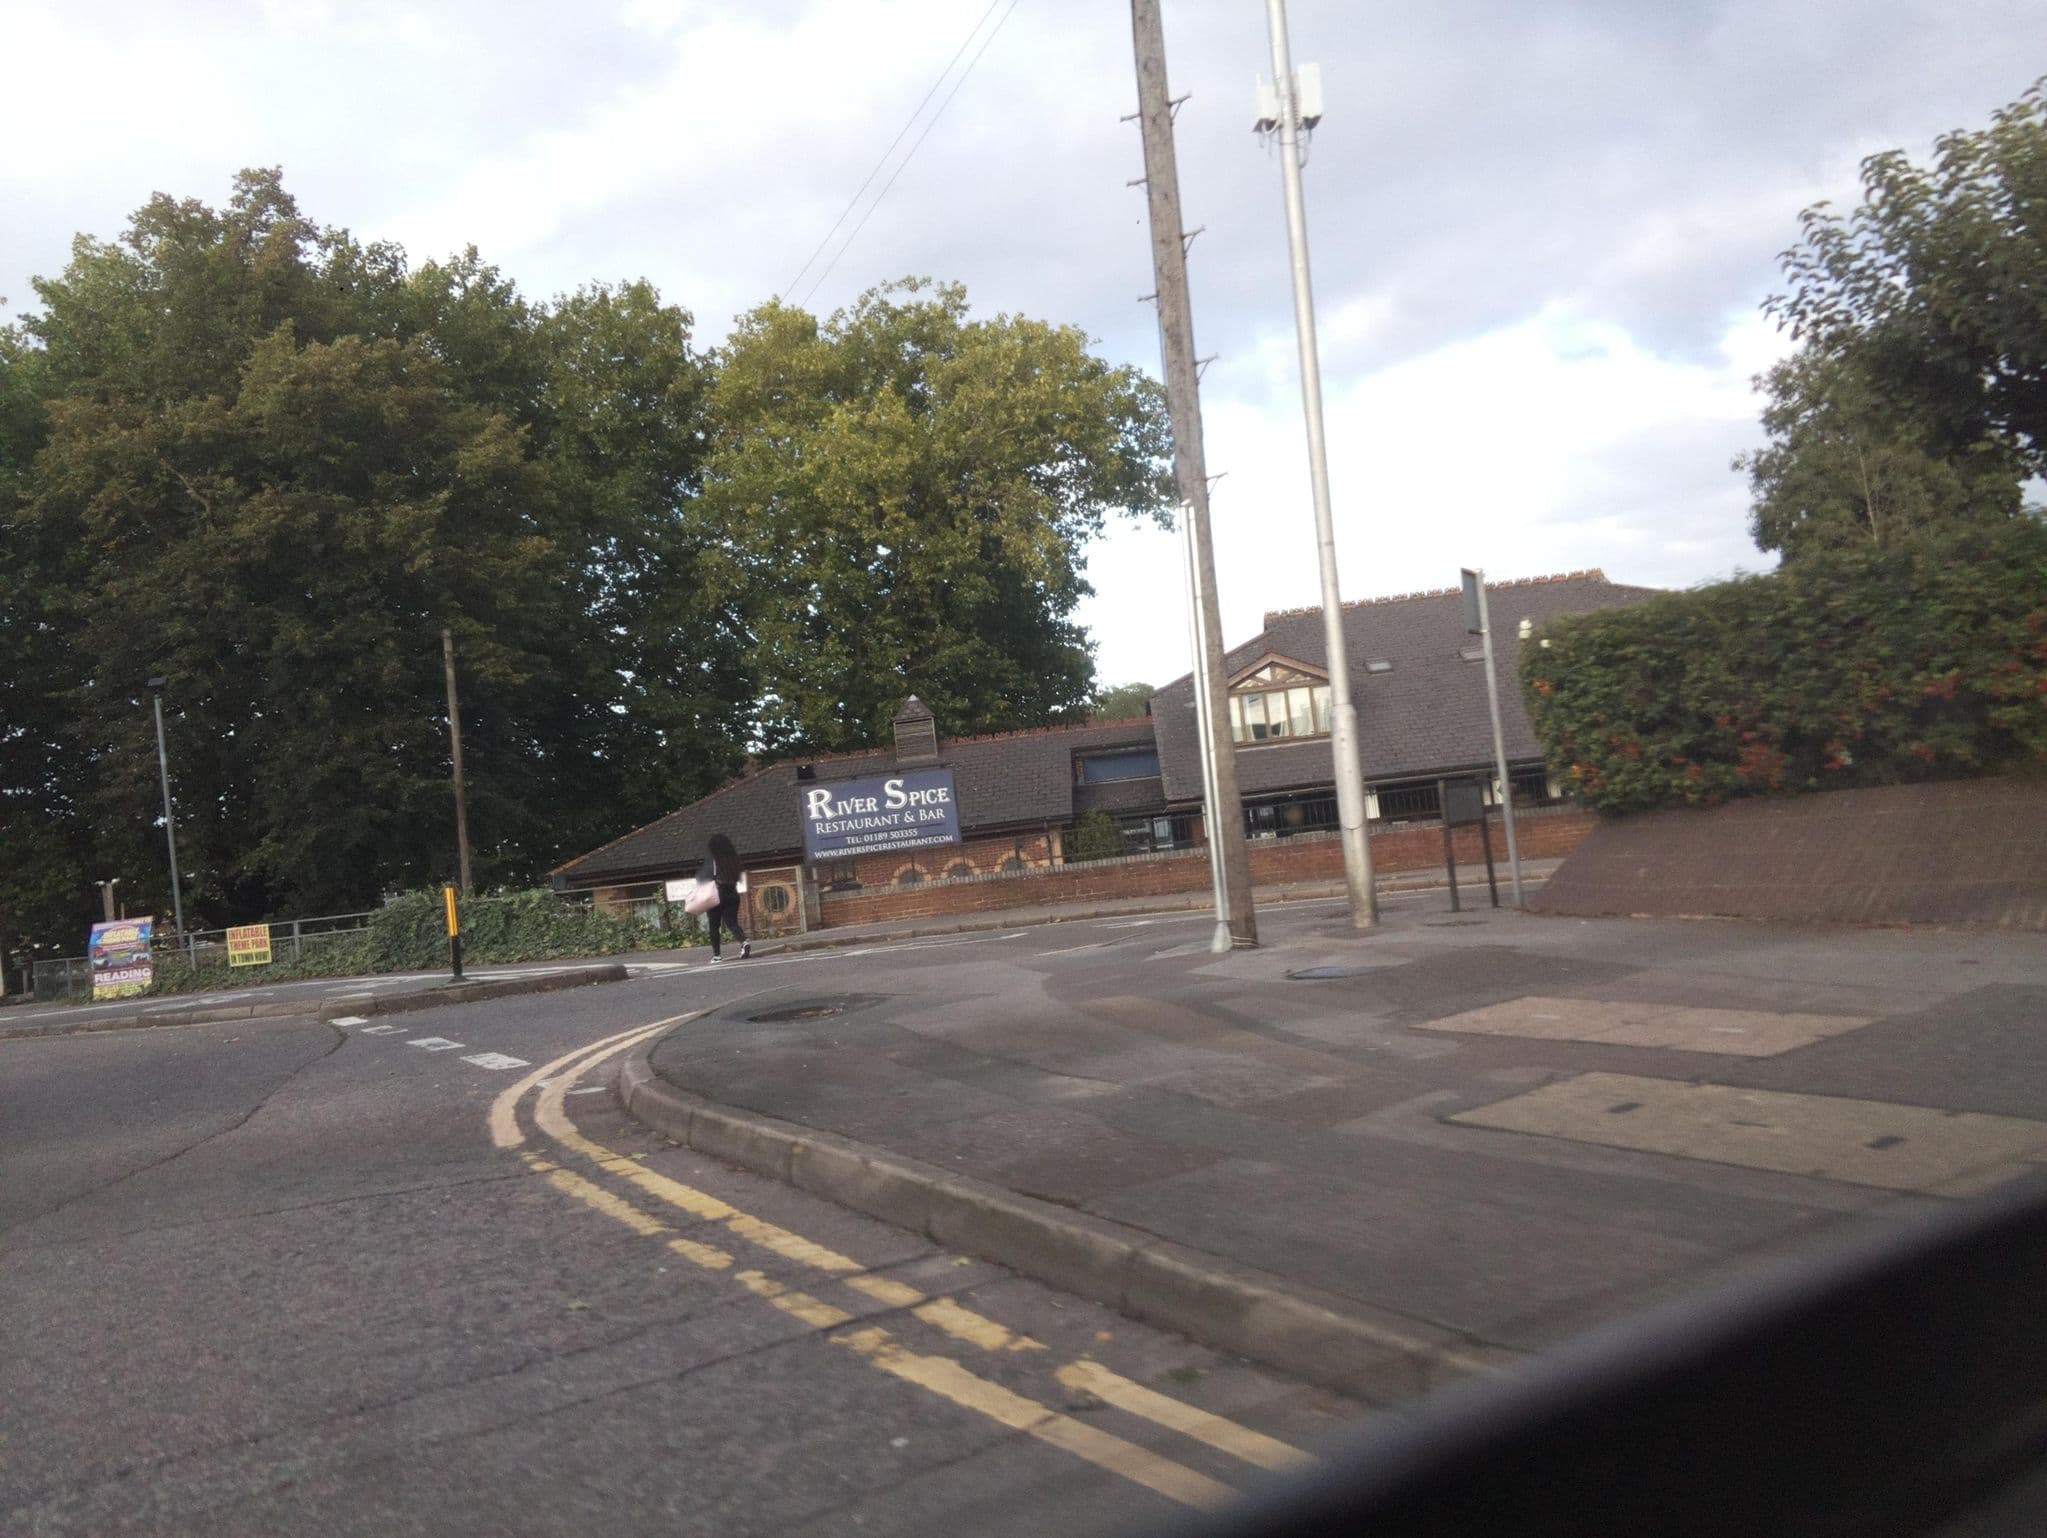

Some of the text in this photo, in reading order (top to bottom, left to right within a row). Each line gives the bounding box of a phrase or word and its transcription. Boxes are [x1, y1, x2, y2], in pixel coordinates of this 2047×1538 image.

[815, 808, 945, 834] RESTAURANT & BAR
[94, 968, 152, 983] READING
